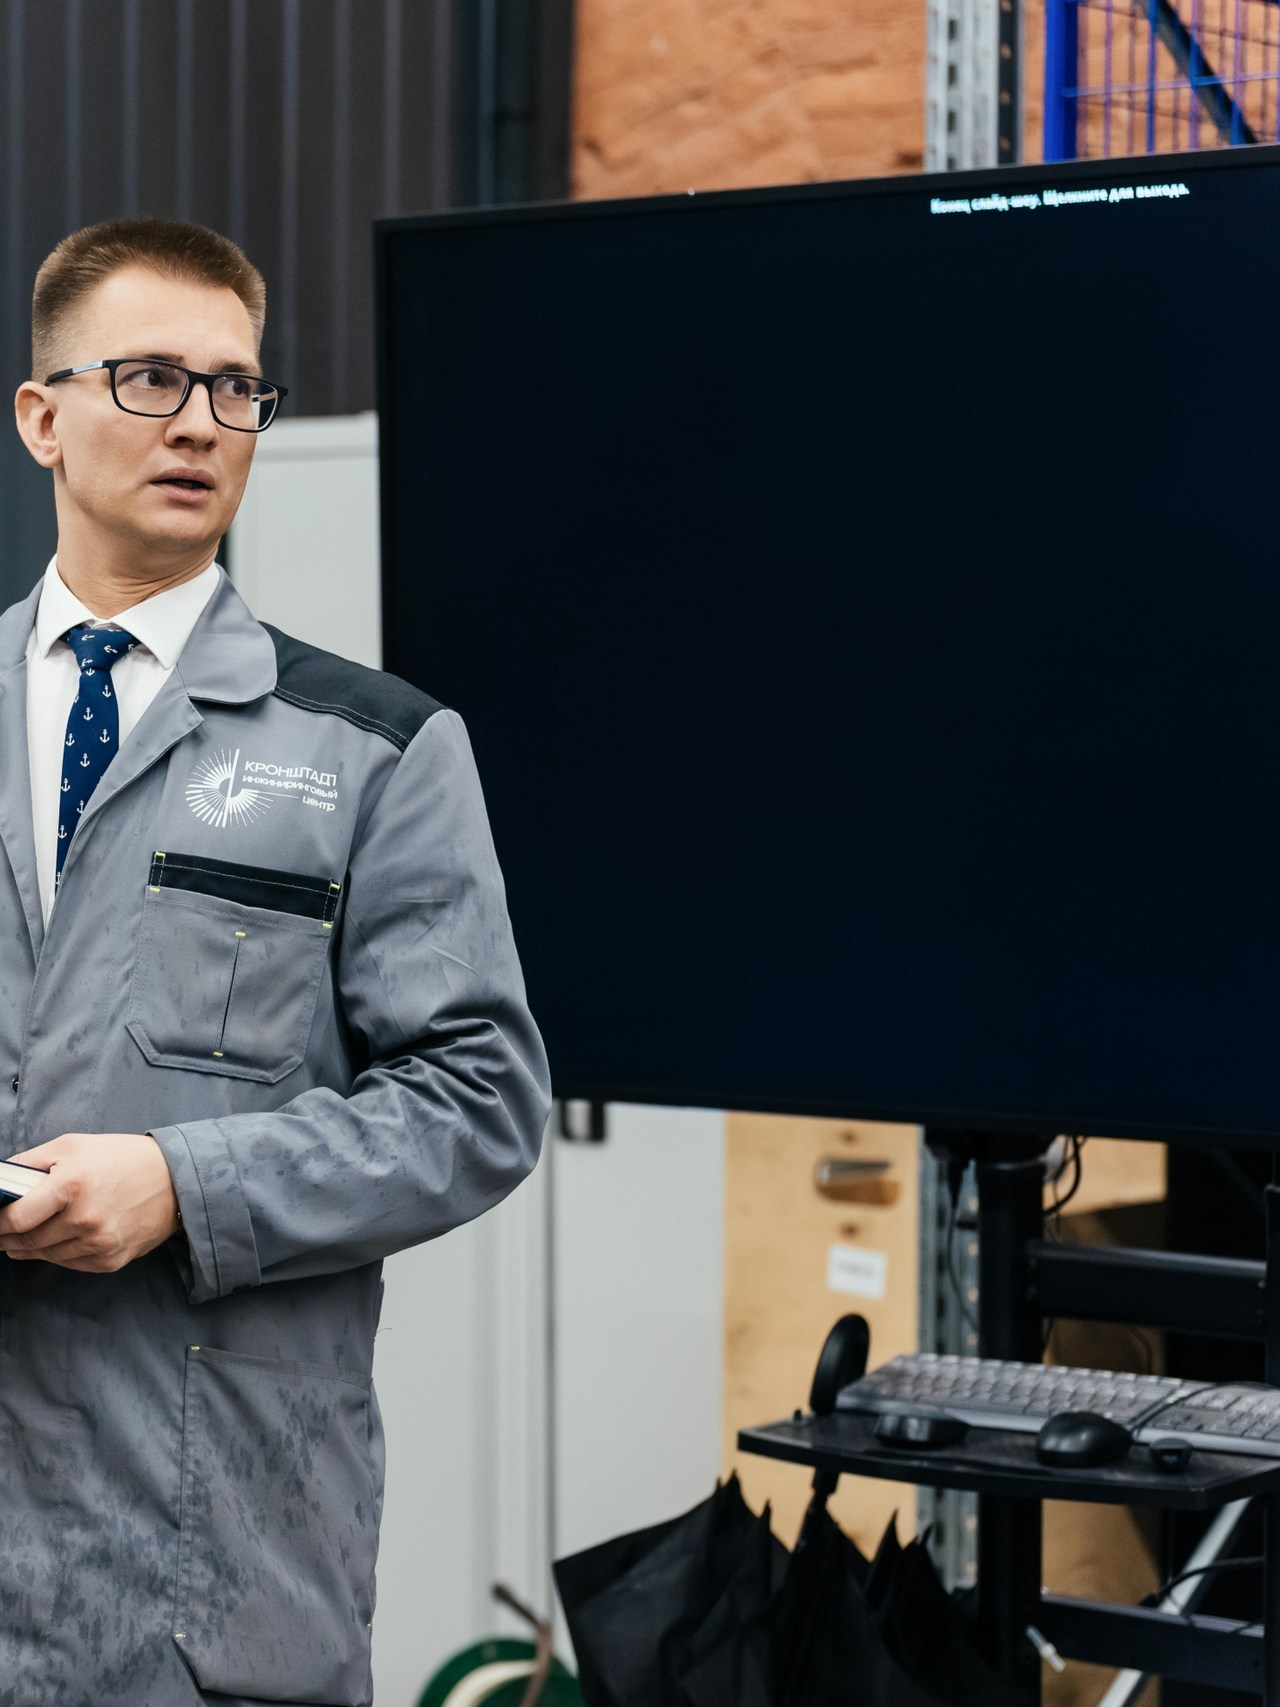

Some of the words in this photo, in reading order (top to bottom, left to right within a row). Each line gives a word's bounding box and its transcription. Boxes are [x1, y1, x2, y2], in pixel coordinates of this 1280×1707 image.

[930, 198, 971, 214] Конец
[1043, 189, 1108, 207] Щелкните
[1109, 186, 1134, 203] для
[1136, 183, 1190, 199] выхода.
[302, 795, 336, 812] центр
